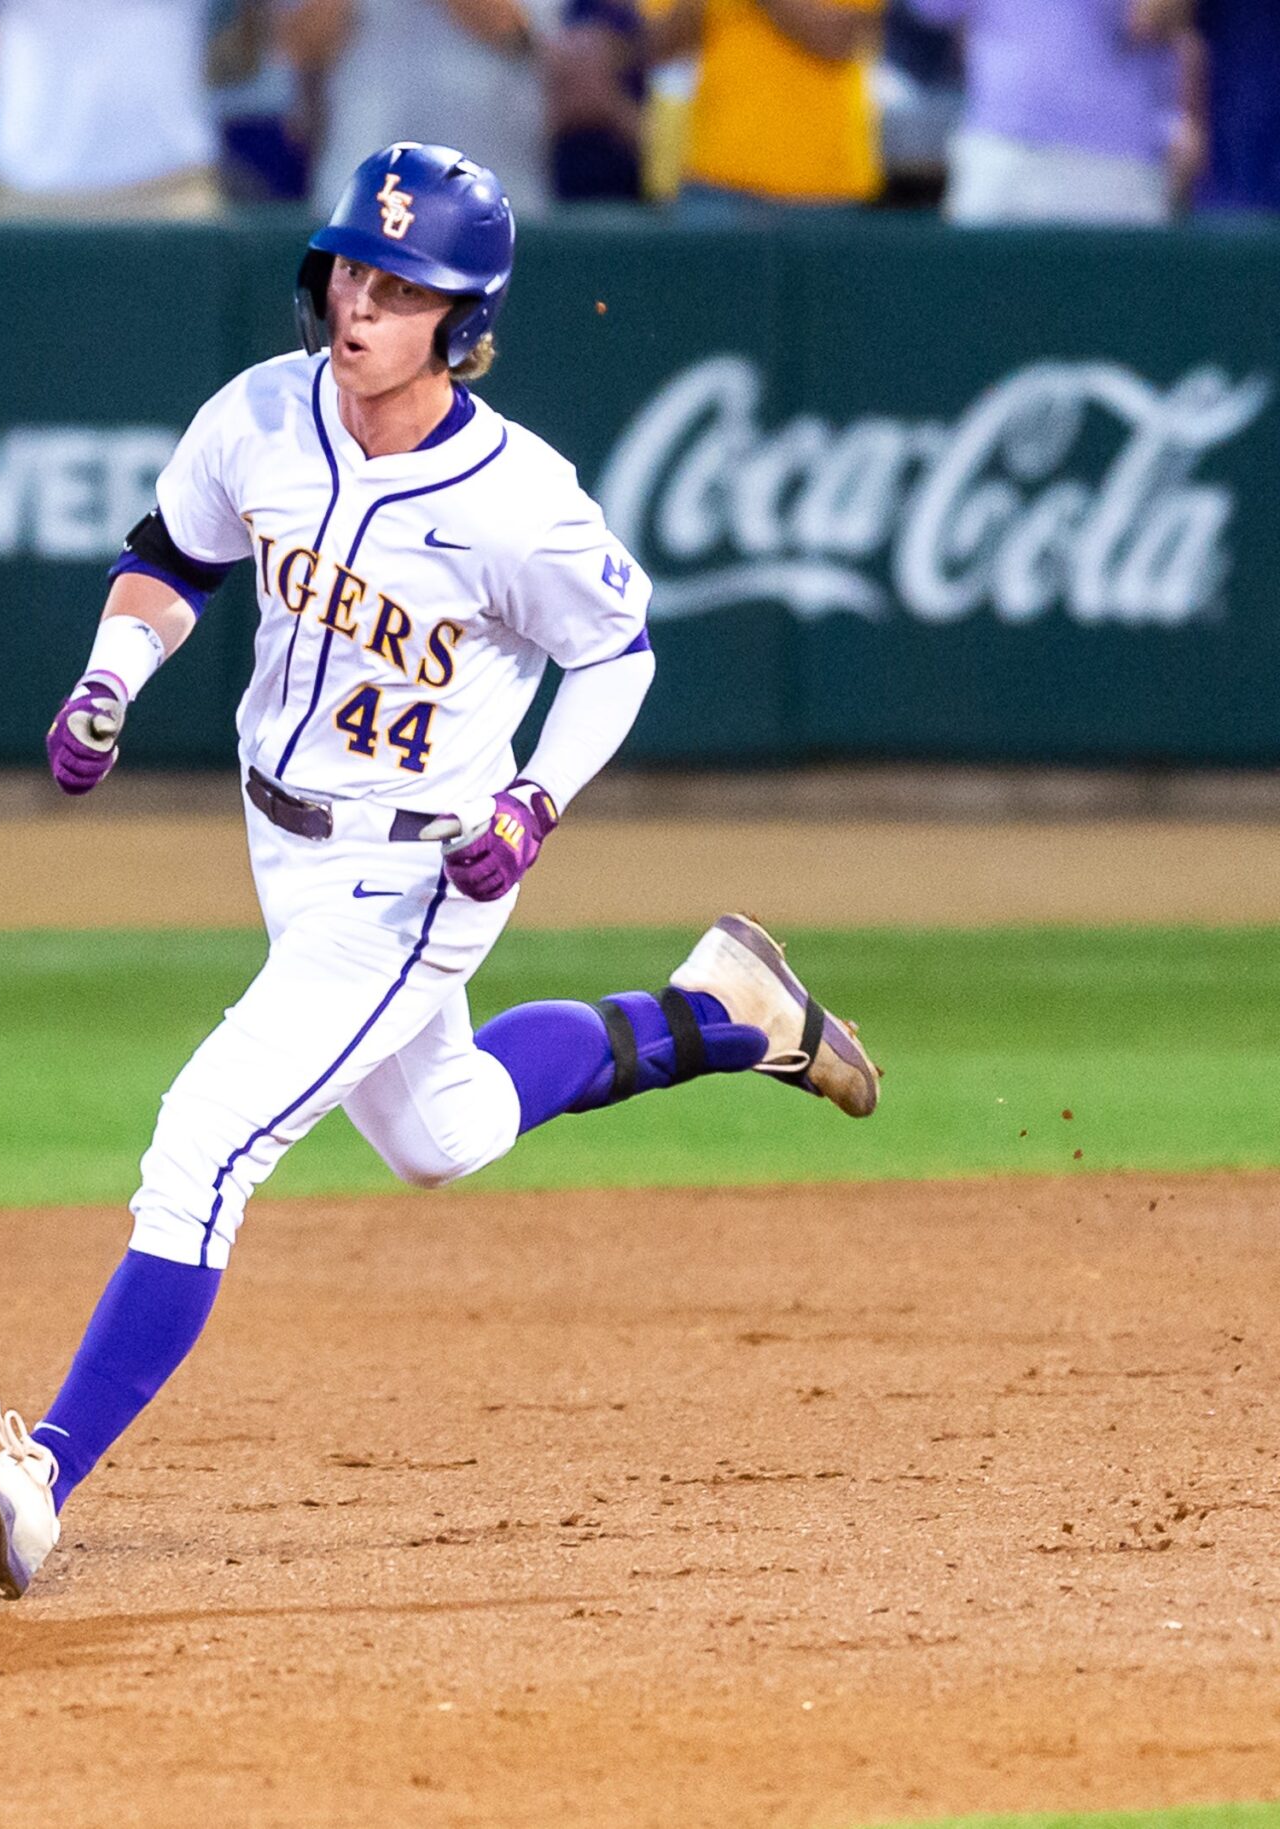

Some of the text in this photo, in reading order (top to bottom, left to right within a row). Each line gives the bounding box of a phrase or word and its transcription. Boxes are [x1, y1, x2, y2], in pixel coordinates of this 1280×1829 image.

[376, 173, 415, 239] LSU
[241, 512, 464, 687] IGERS
[334, 682, 437, 773] 44
